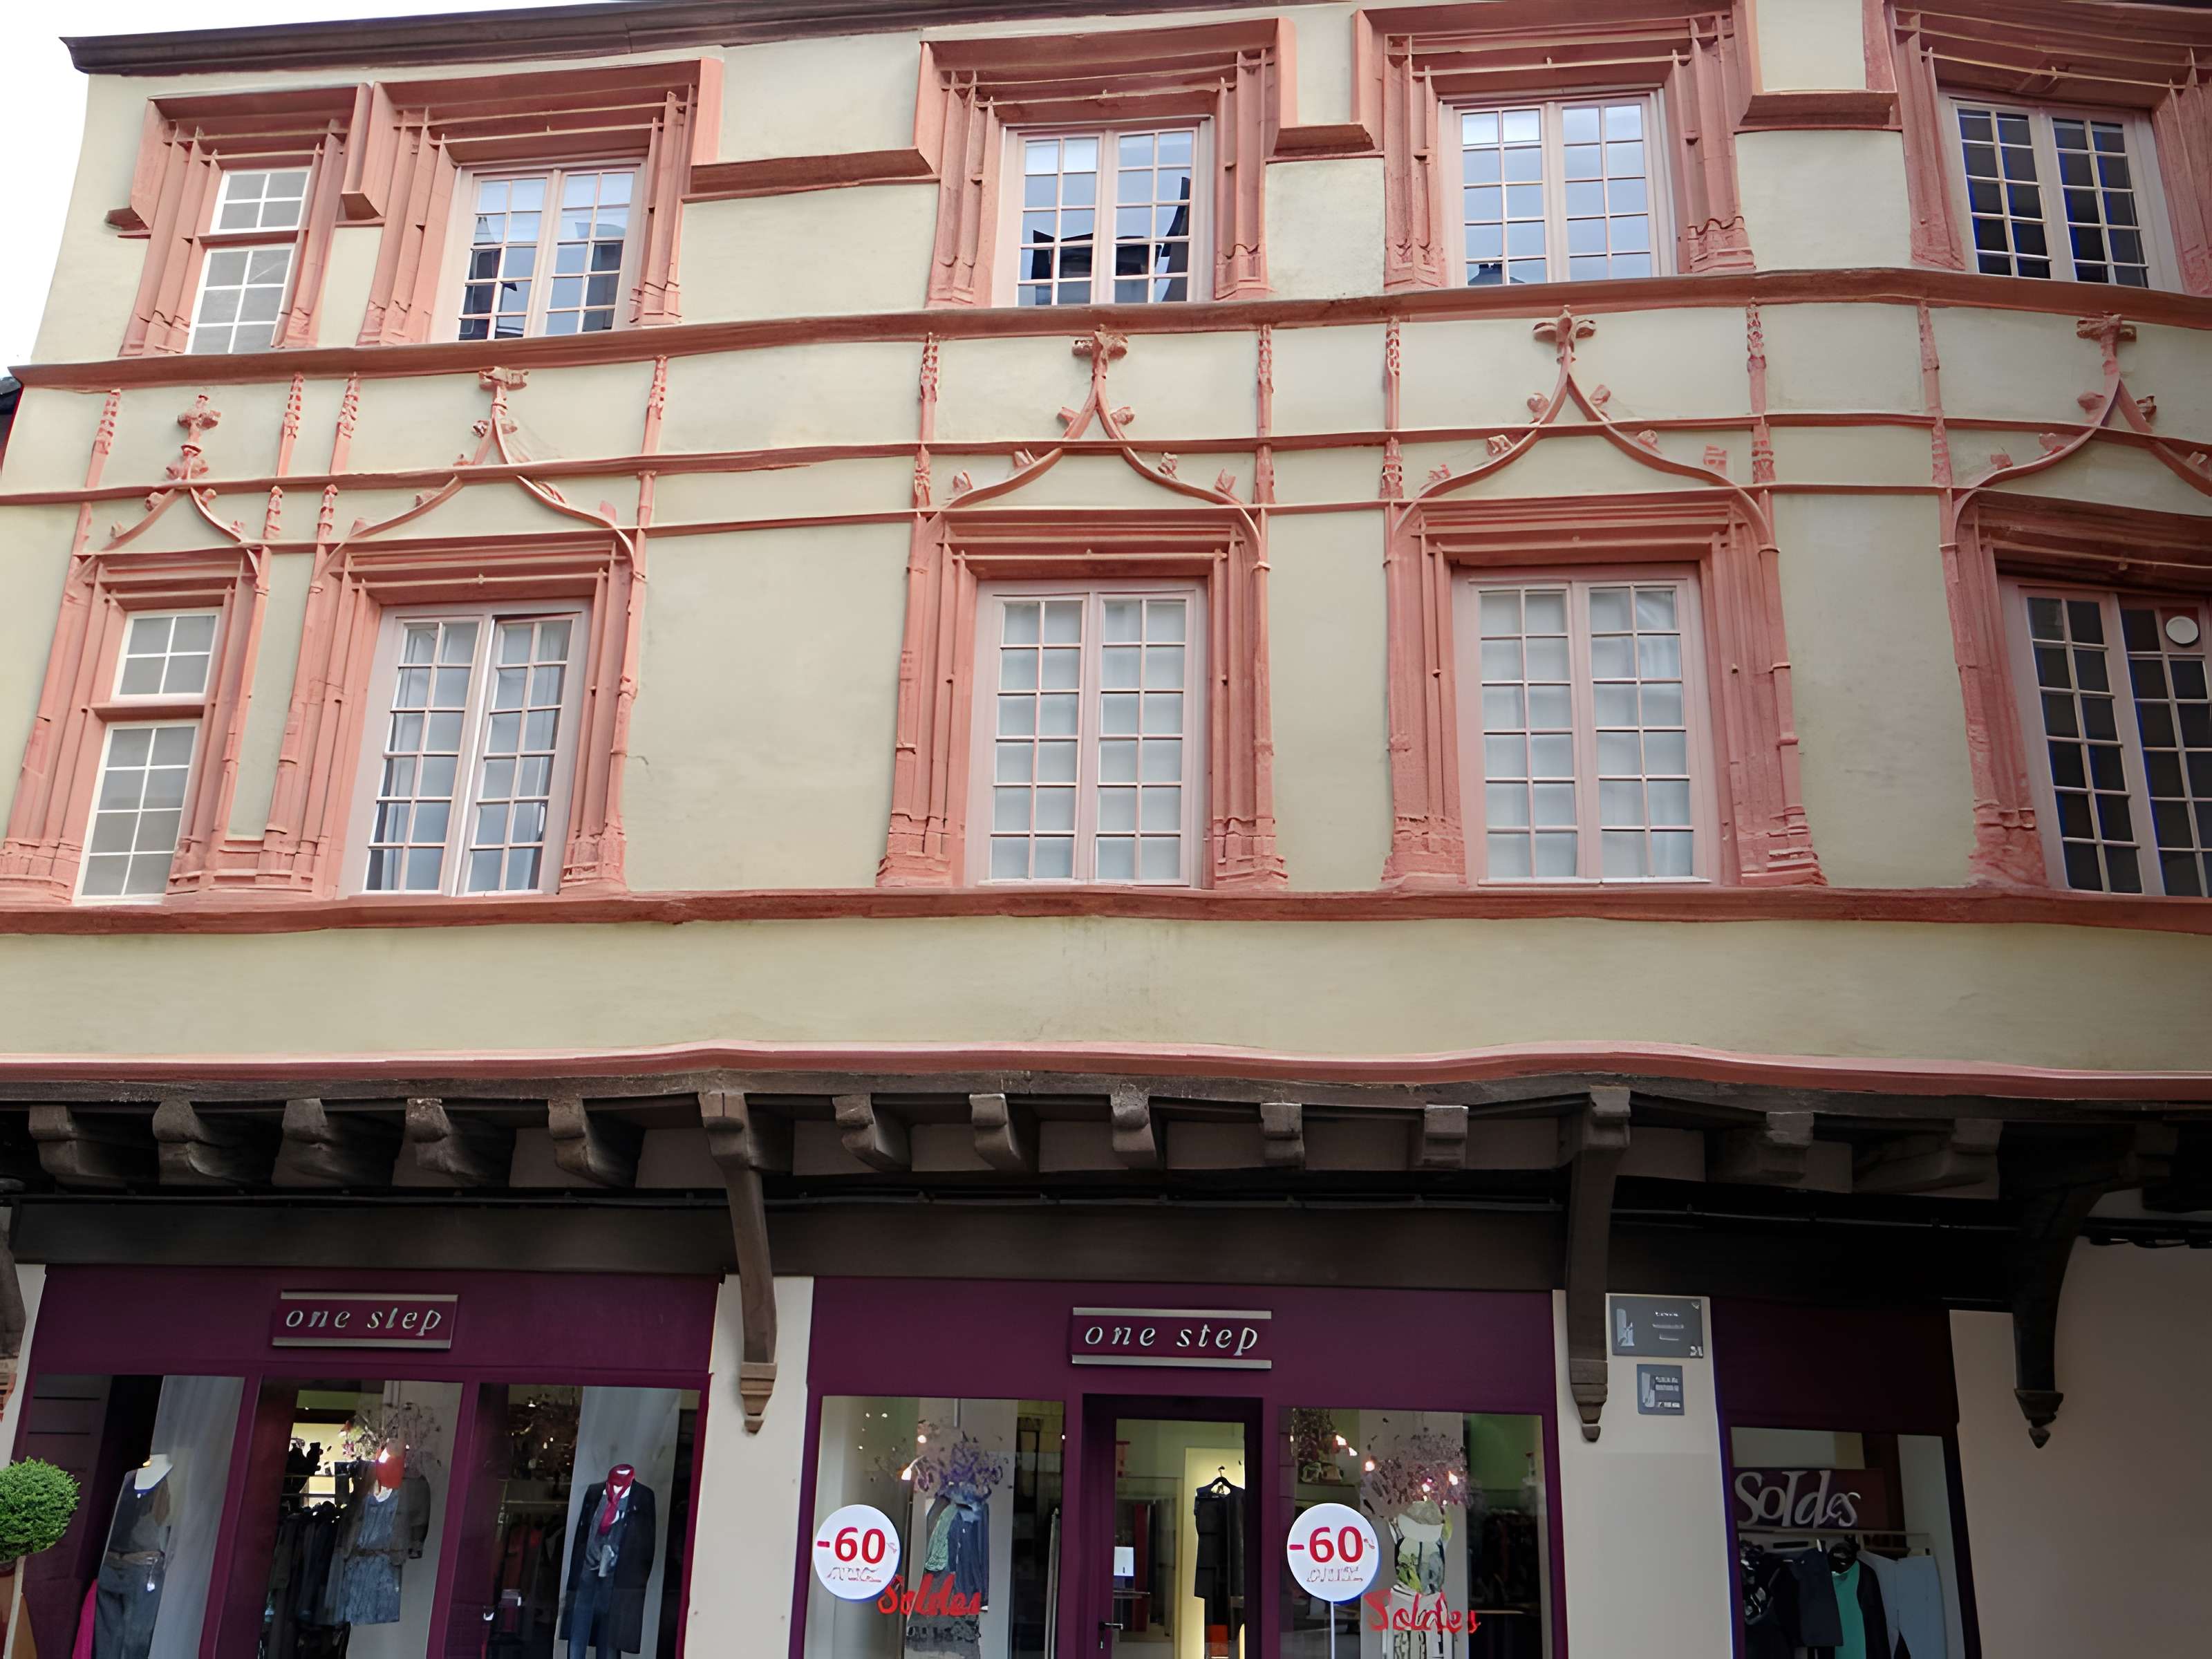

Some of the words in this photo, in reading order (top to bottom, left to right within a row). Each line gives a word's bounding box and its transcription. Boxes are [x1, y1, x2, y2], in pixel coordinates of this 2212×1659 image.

[285, 1310, 350, 1328] one
[1085, 1327, 1156, 1346] one
[1176, 1324, 1257, 1356] step
[817, 1526, 897, 1564] -60
[1288, 1526, 1376, 1563] -60
